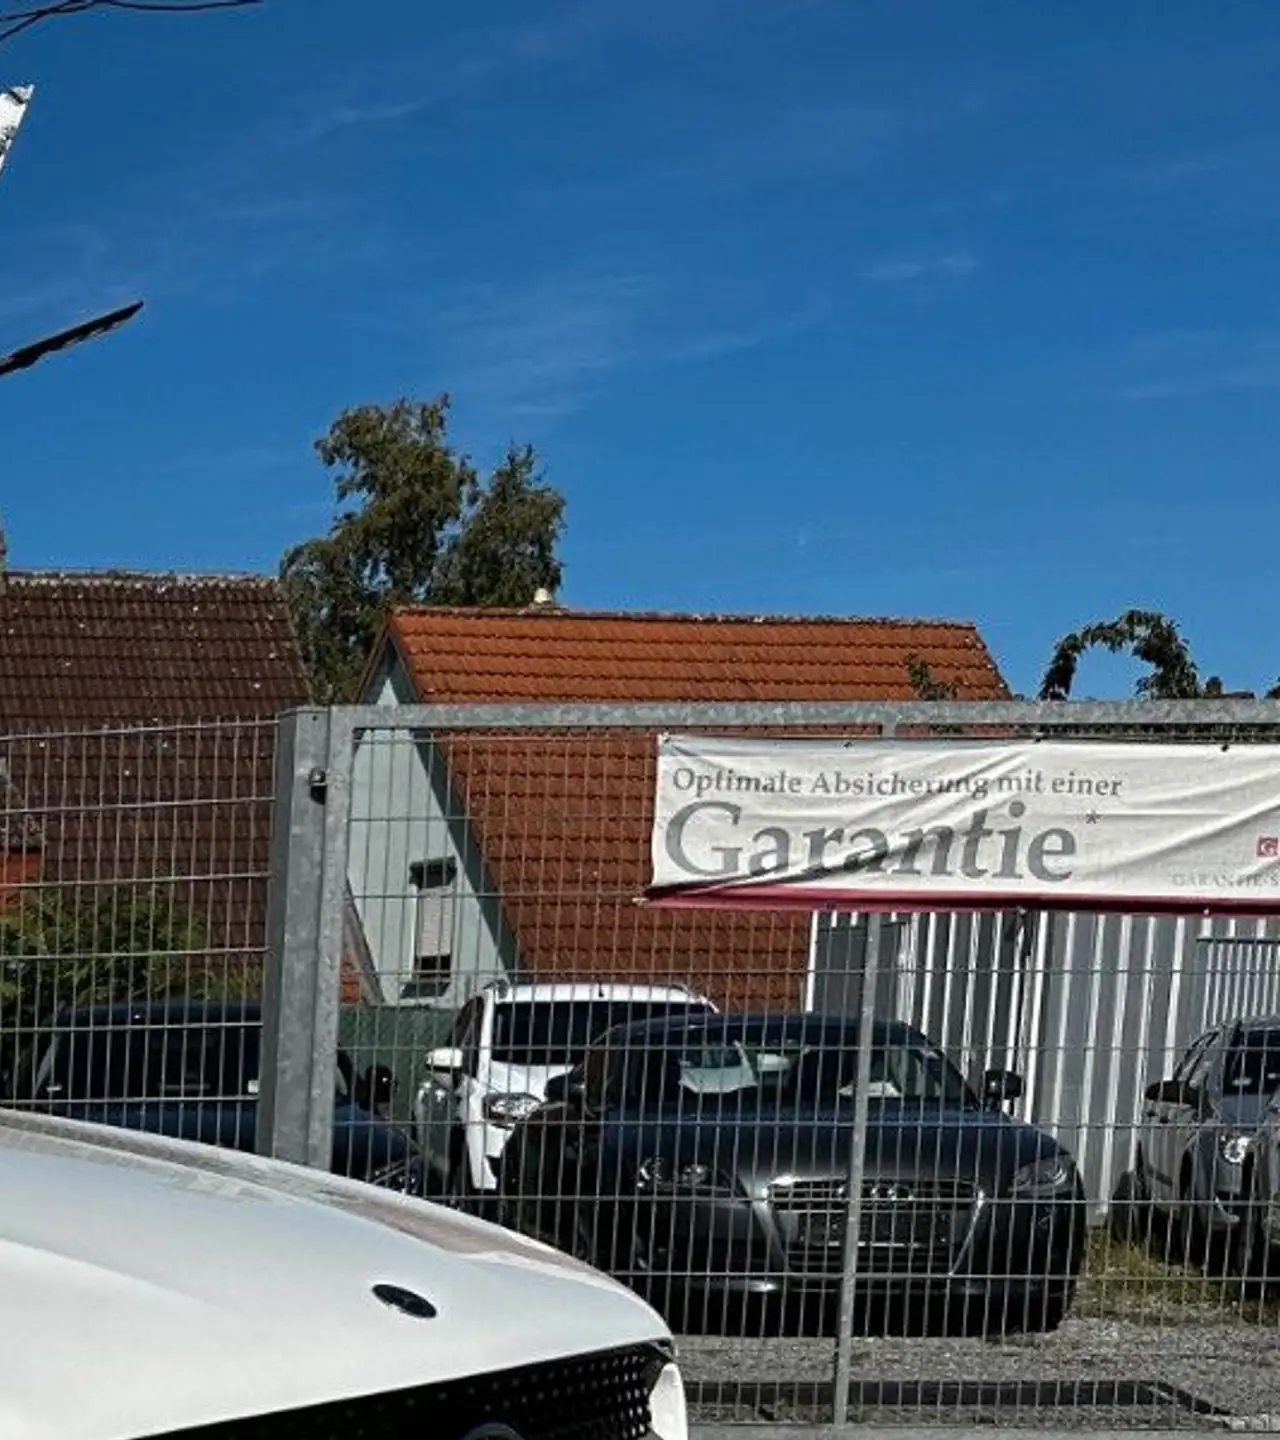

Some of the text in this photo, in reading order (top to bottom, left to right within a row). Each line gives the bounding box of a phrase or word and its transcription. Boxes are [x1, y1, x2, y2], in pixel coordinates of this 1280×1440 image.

[672, 767, 1124, 799] Optimale Absicherung mit einer
